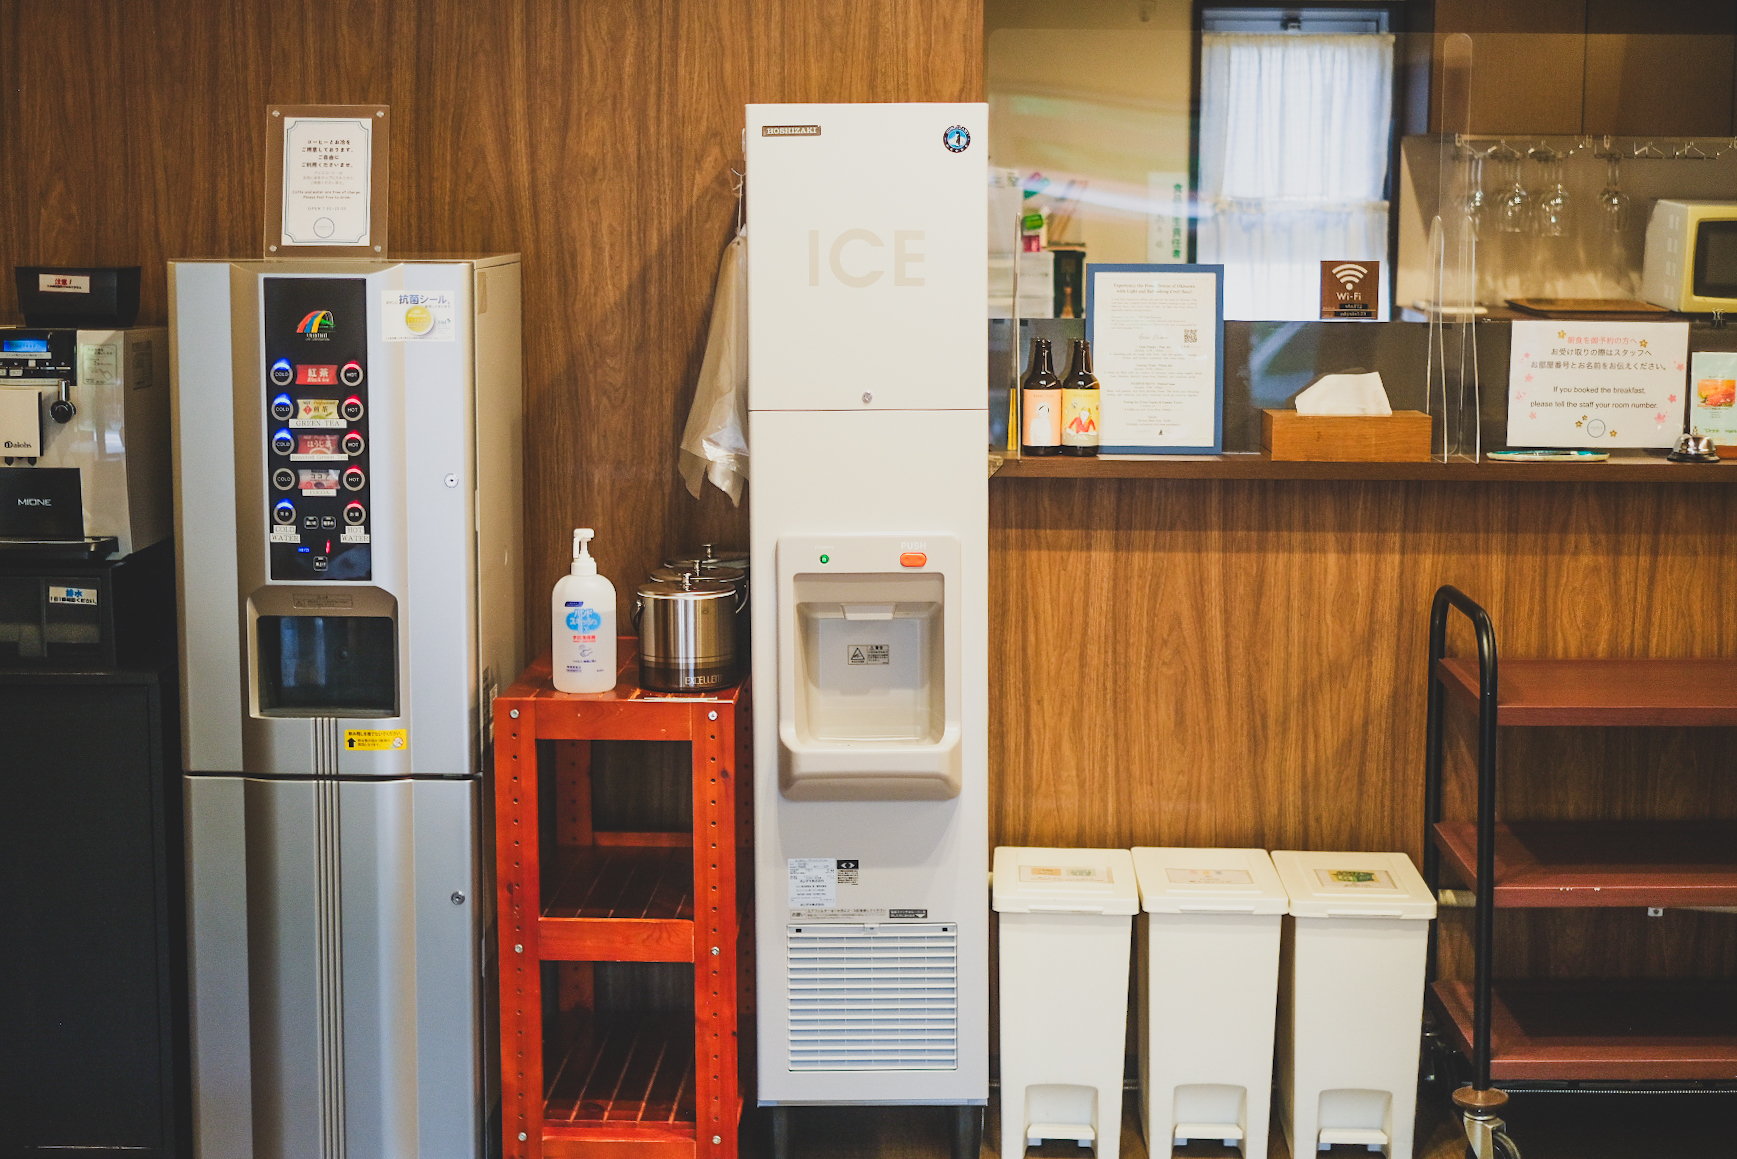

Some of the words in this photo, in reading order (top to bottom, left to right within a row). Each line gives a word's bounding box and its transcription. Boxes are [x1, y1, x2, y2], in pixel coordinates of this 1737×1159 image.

[766, 127, 817, 136] HOSHIZAKI
[808, 228, 925, 288] ICE
[1336, 292, 1362, 301] Wi-Fi
[1567, 336, 1638, 345] 朝食を御予約の方へ
[1550, 348, 1652, 357] お受け取りの際はスタッフへ
[1530, 361, 1667, 371] お部屋番号とお名前をお伝えください。
[307, 368, 329, 377] 紅茶
[1559, 387, 1572, 395] you
[1530, 401, 1553, 409] please
[307, 440, 332, 448] ほうじ茶
[17, 498, 52, 507] MIONE
[347, 526, 363, 534] HOT
[271, 534, 299, 542] WATER
[900, 542, 927, 550] PUSH
[574, 608, 594, 618] ハンド
